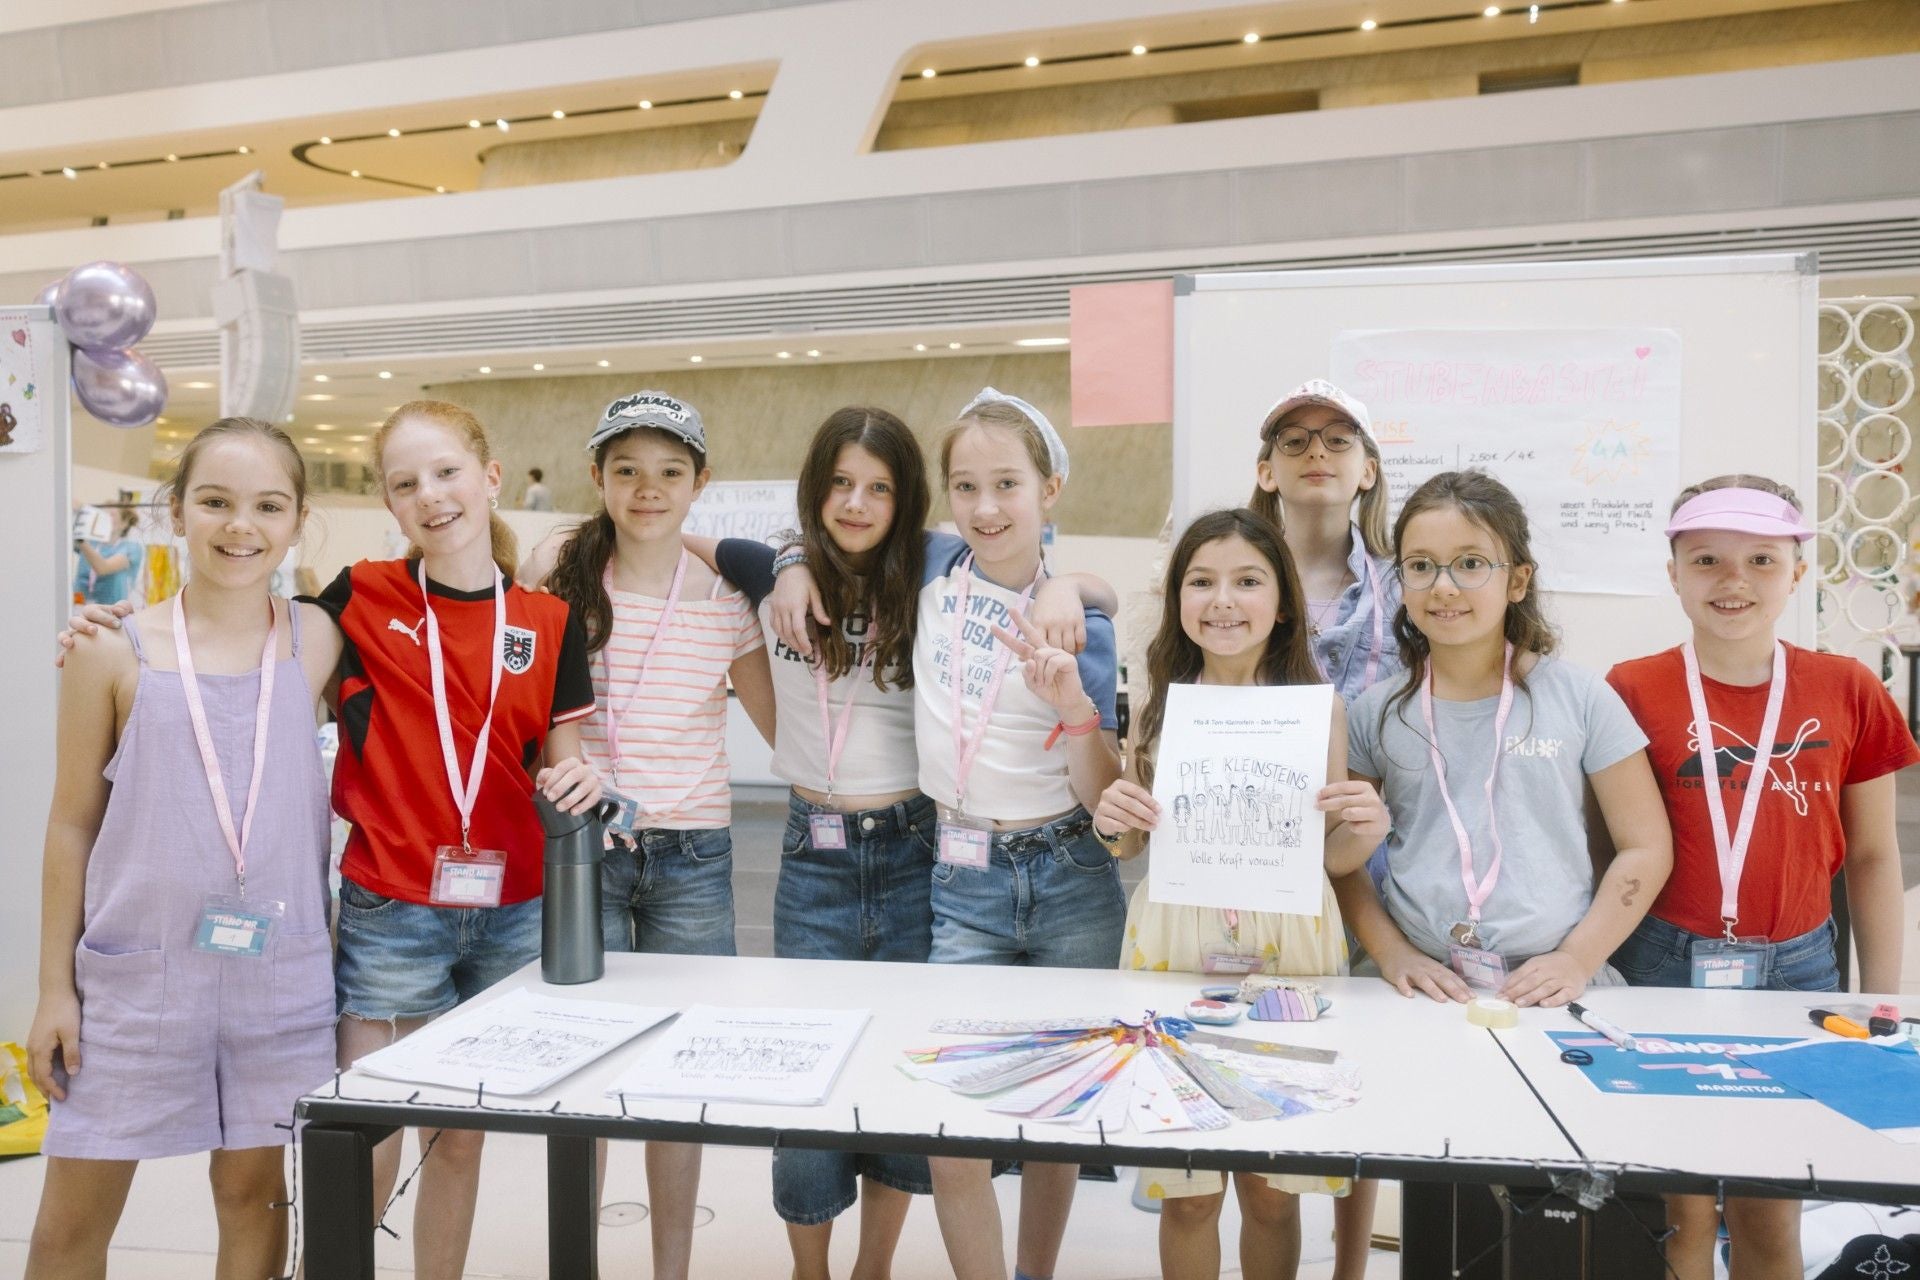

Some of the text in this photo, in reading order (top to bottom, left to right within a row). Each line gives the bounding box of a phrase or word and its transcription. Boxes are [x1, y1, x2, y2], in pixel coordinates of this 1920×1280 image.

[942, 595, 1014, 631] NWPO
[961, 619, 994, 651] USA
[933, 650, 993, 684] NE YOR
[1180, 758, 1308, 791] DIE KLEINSTEINS
[1190, 851, 1285, 869] Volle Kraft voraus!
[1696, 1083, 1785, 1094] MARKTTAG
